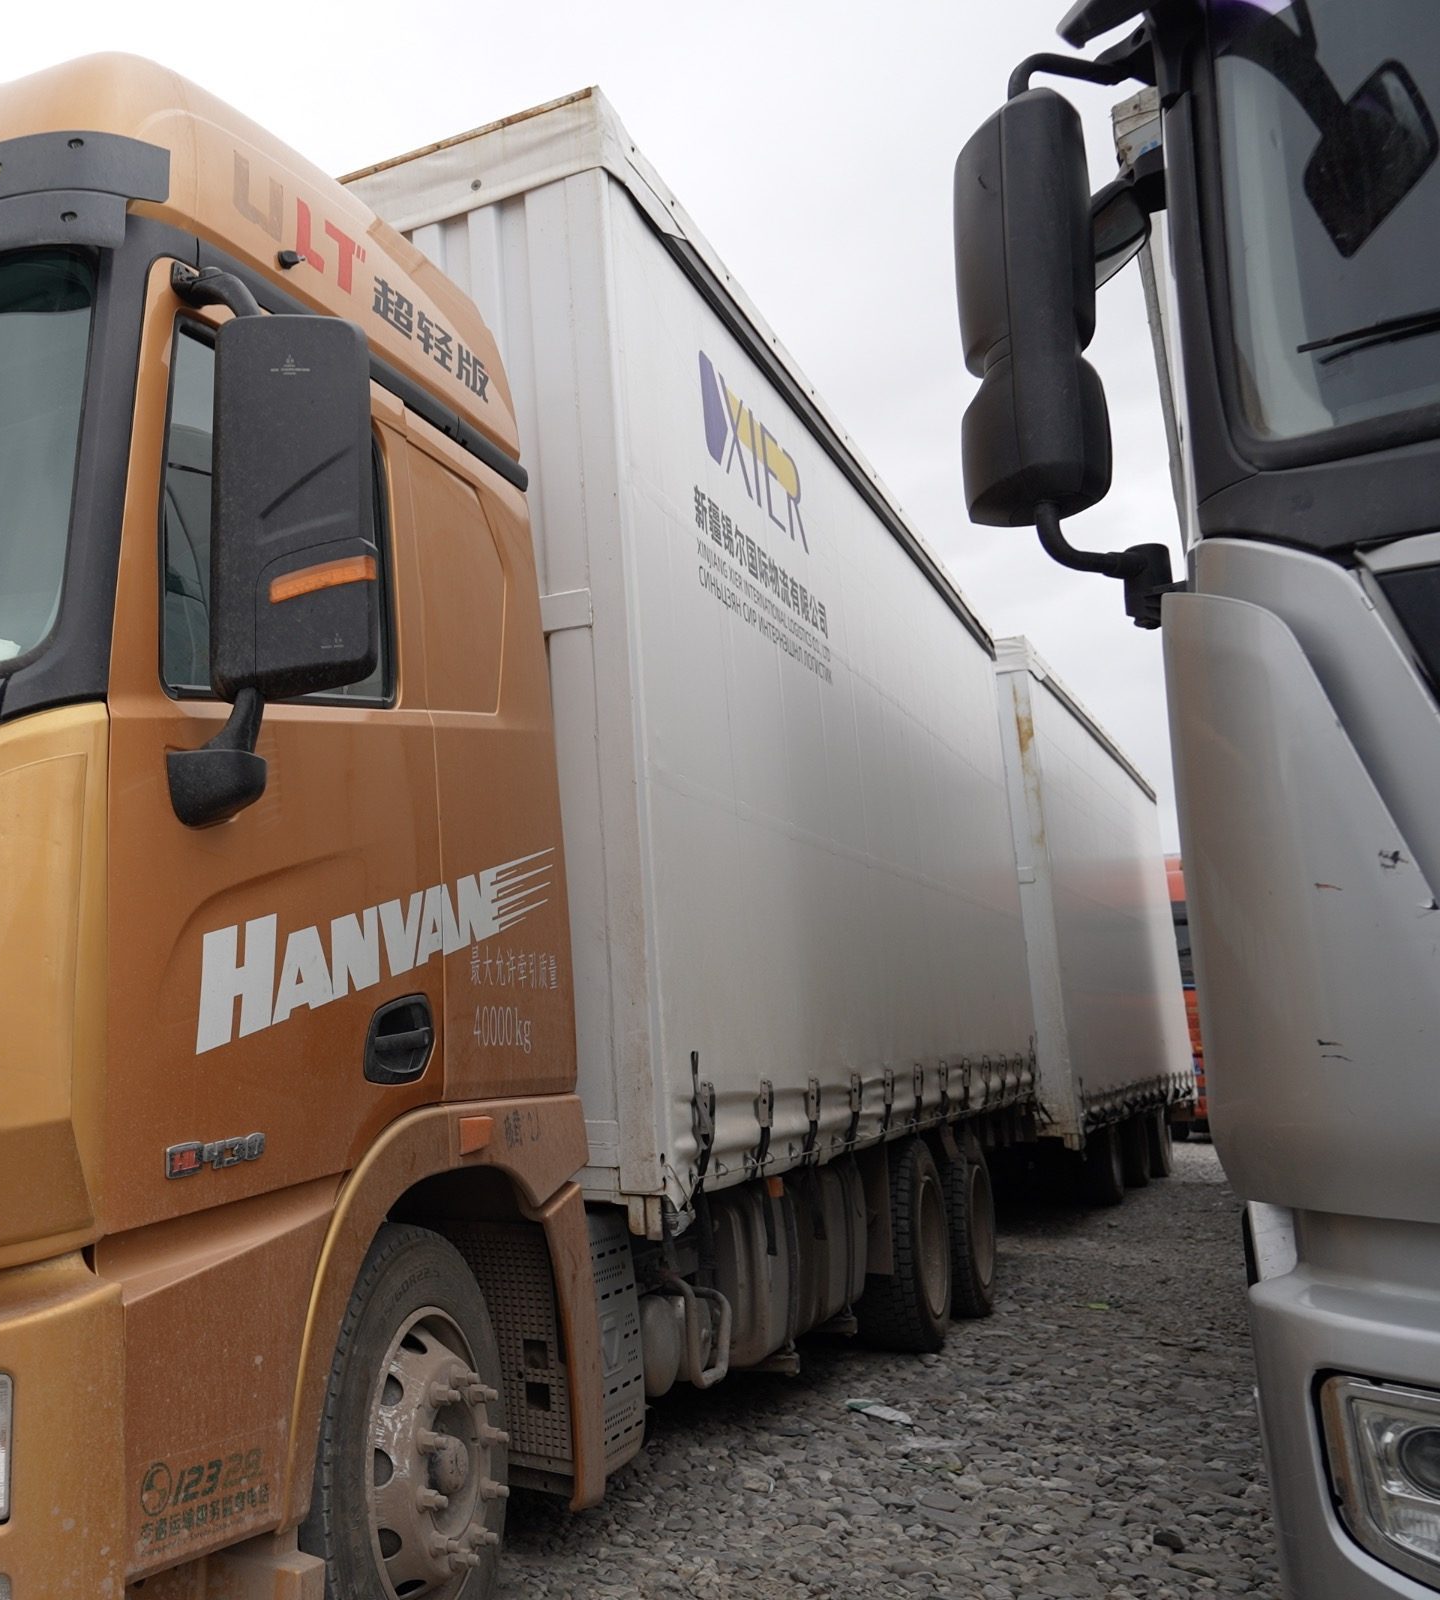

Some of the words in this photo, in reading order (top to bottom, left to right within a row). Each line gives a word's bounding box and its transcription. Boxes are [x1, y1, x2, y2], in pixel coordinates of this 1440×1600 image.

[372, 276, 490, 404] 超轻版
[196, 858, 525, 1055] HANVAN
